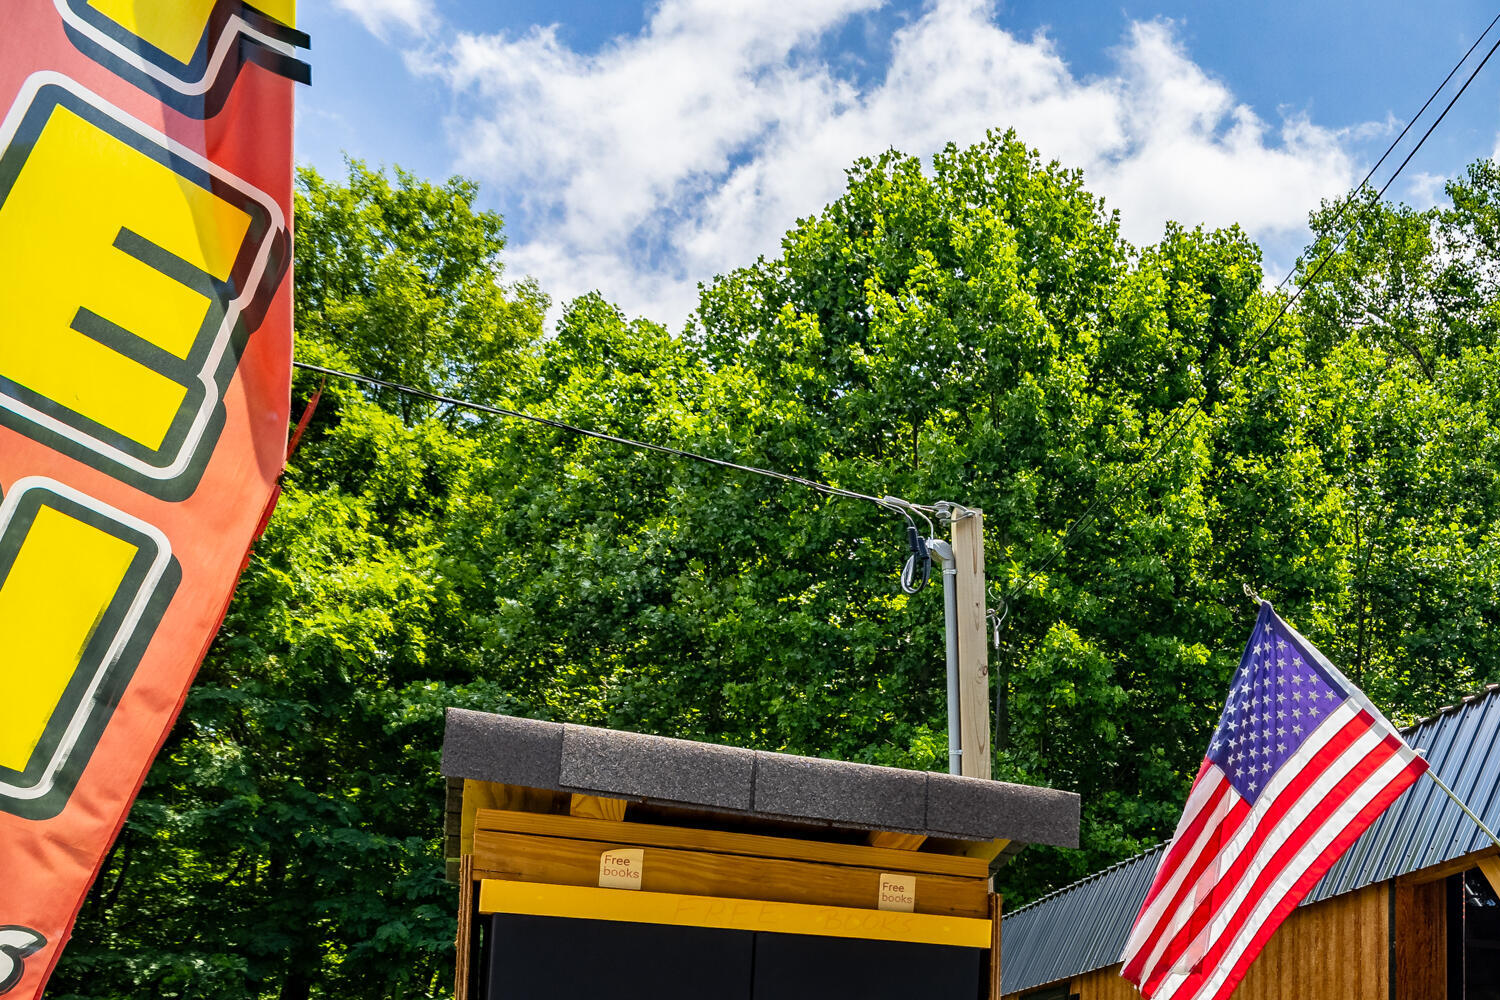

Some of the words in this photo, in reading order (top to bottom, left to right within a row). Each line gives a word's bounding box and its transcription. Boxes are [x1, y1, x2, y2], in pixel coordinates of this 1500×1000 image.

[603, 854, 631, 867] Free
[603, 866, 640, 880] books
[882, 881, 905, 893] Free
[881, 892, 914, 905] books
